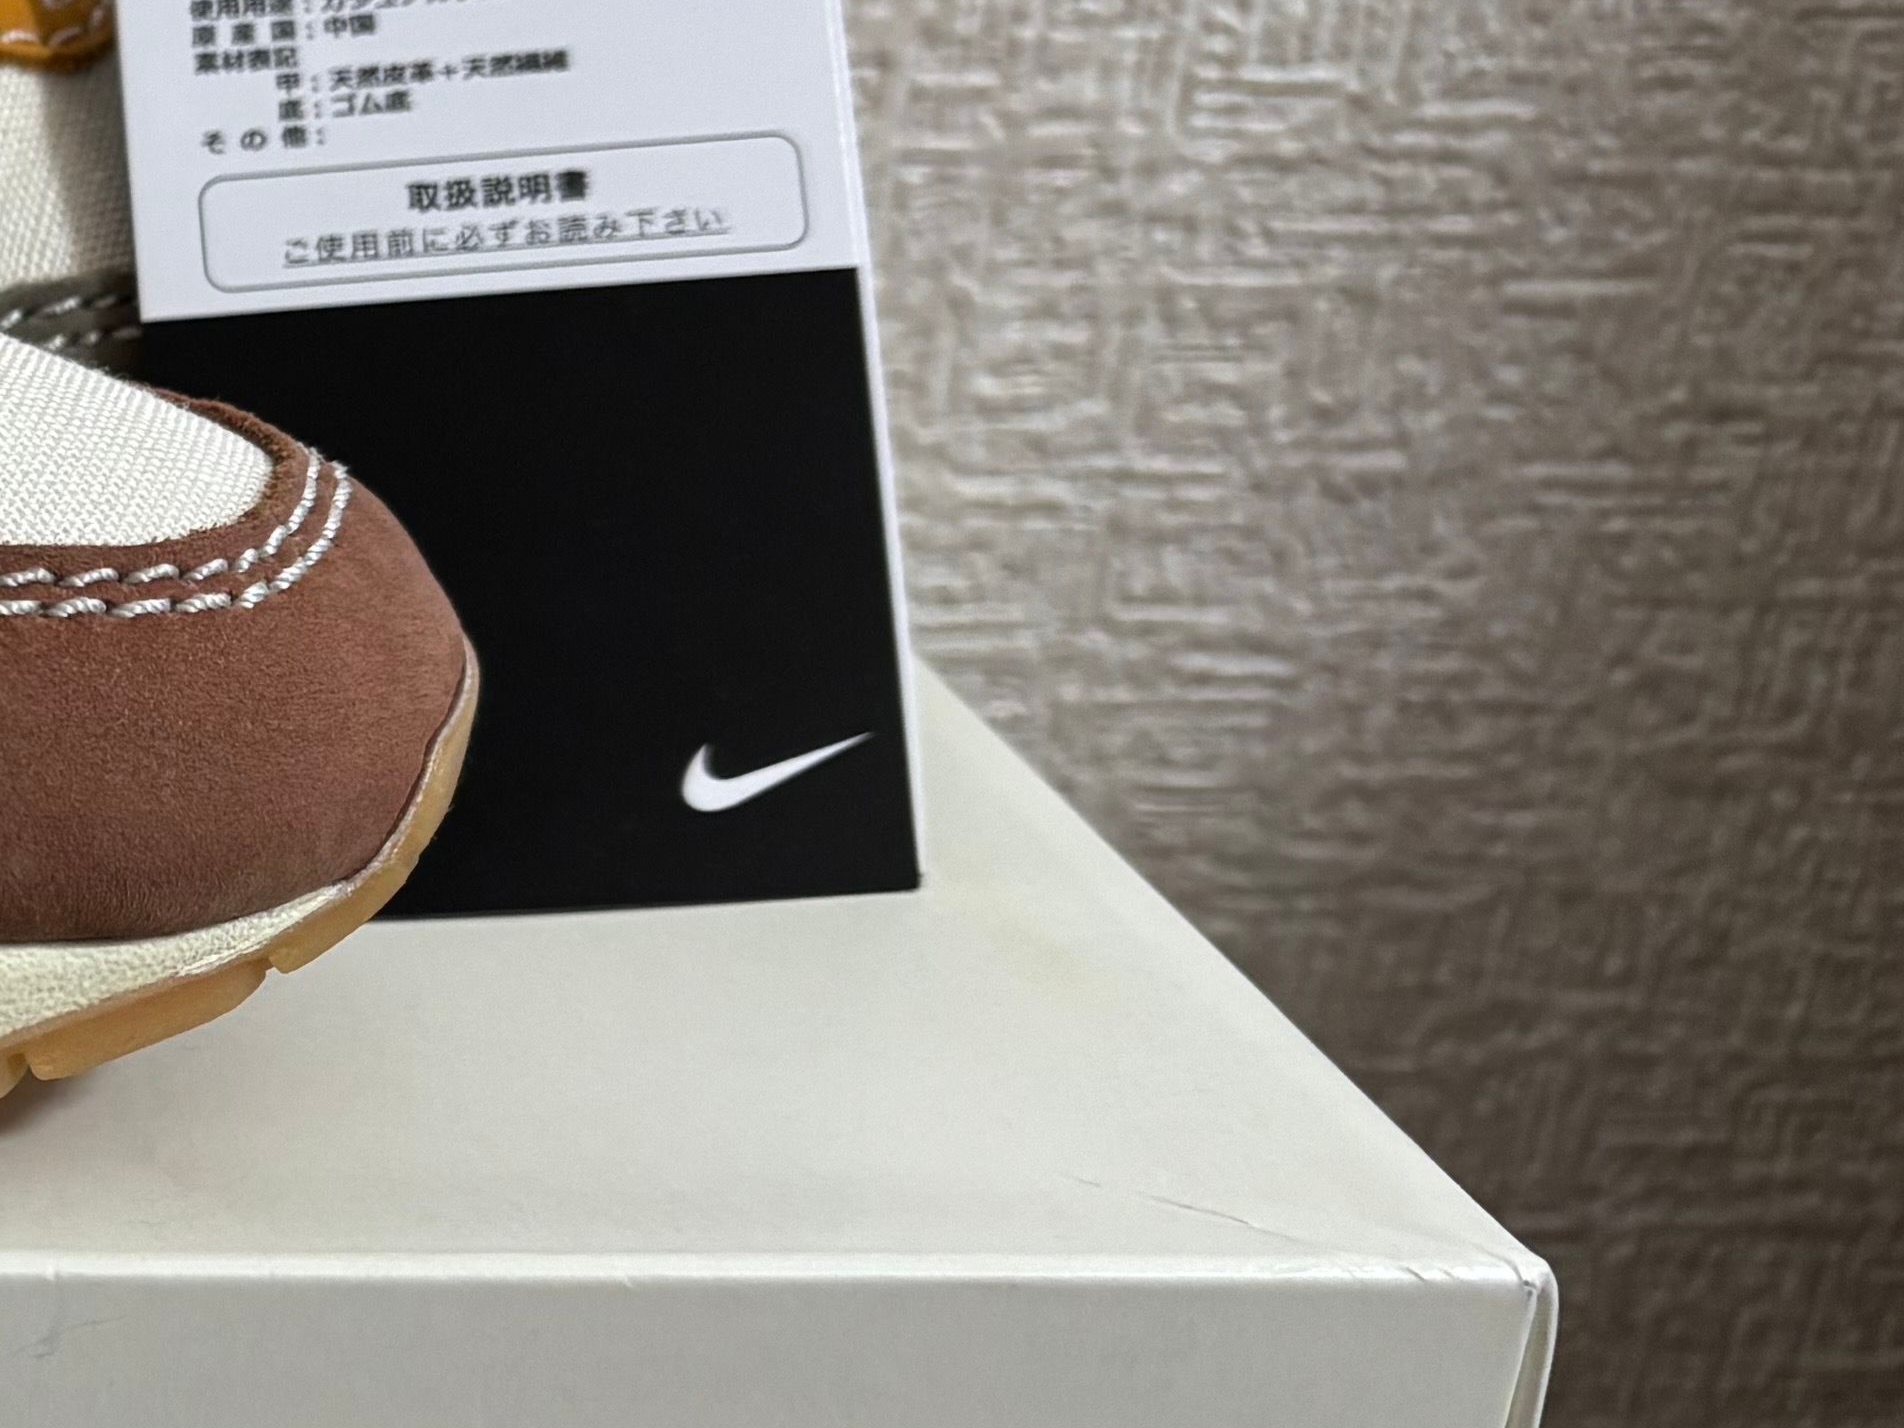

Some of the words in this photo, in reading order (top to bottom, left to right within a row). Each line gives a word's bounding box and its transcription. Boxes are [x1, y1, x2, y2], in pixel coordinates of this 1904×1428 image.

[406, 170, 591, 214] 取扱説明書
